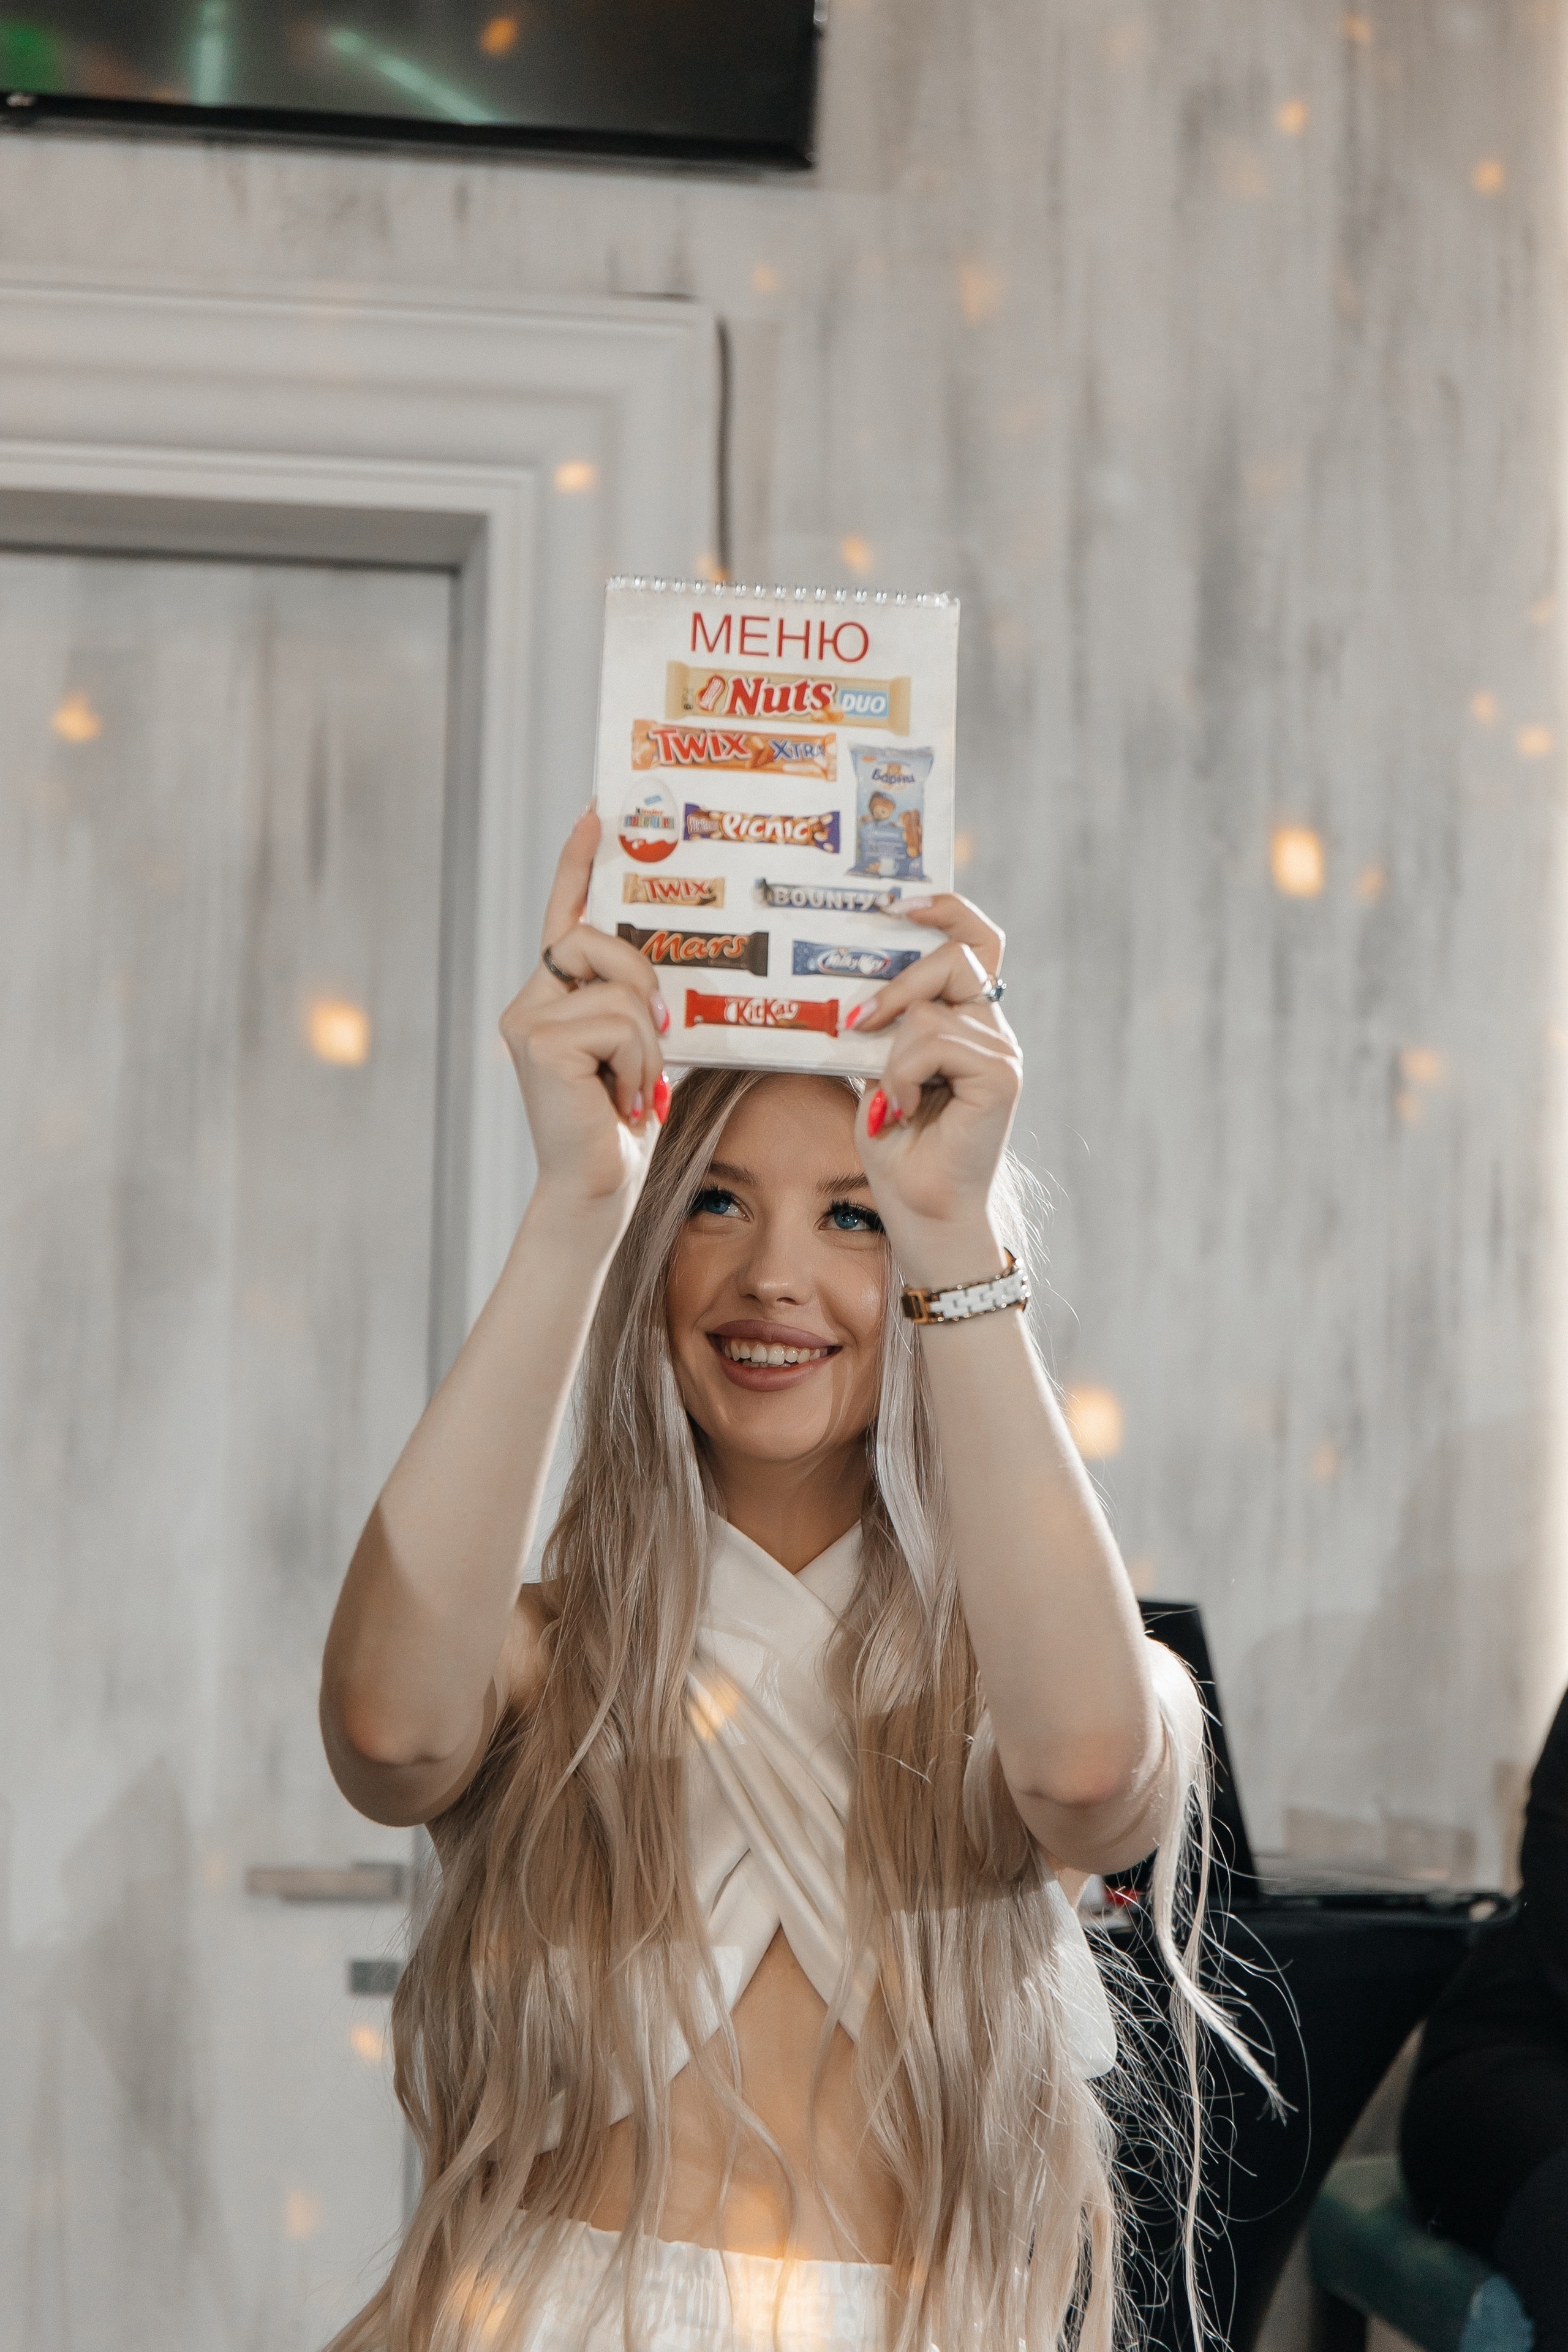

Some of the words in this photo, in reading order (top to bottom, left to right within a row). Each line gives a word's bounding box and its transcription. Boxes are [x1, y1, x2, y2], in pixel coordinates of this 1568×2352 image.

[690, 611, 869, 663] МЕНЮ
[723, 676, 834, 716] Nuts
[841, 692, 887, 714] DUO
[770, 739, 825, 760] XTRA
[722, 812, 810, 844] Picnic
[774, 888, 875, 911] BOUNTY
[639, 930, 750, 964] Mars
